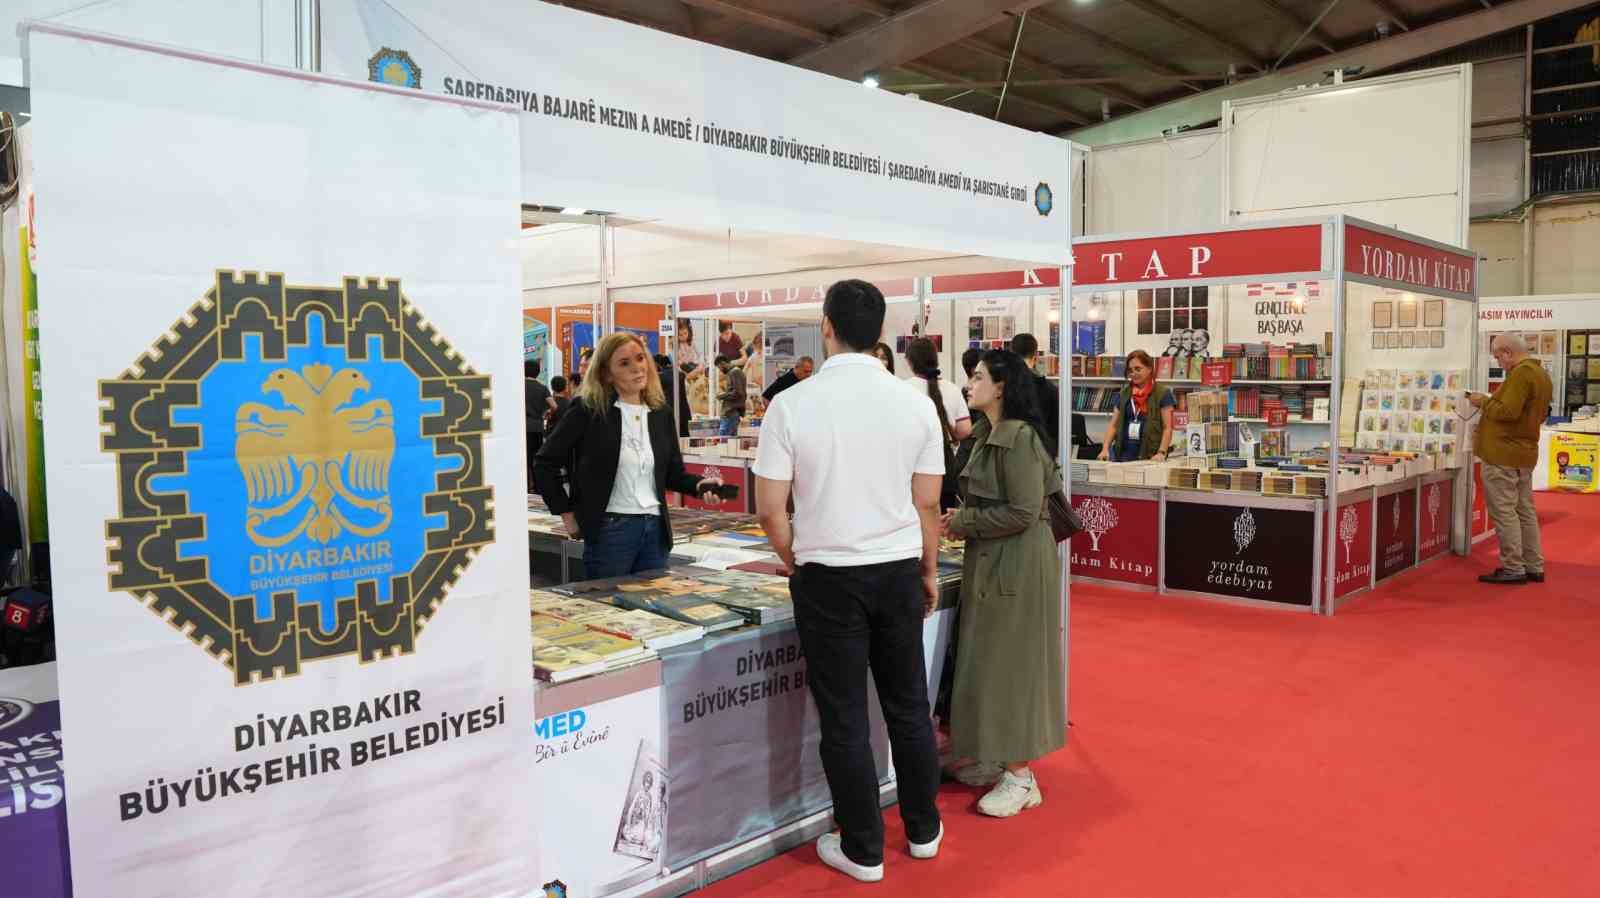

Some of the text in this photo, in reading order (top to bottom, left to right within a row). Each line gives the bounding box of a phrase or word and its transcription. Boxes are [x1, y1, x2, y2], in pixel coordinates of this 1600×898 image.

[543, 94, 596, 123] BAJARÊ
[599, 105, 638, 131] MEZIN
[641, 114, 650, 133] A
[653, 117, 693, 141] AMEDÊ
[703, 121, 769, 154] DİYARBAKIR
[770, 135, 830, 166] BÜYÜKŞEHİR
[832, 151, 881, 175] BELEDİYESİ
[962, 175, 972, 193] YA
[1361, 244, 1472, 293] YORDAM KİTAP
[1257, 318, 1304, 337] BAŞ BAŞA
[249, 540, 393, 576] DİYARBAKIR
[1109, 556, 1154, 577] Kitap
[1211, 559, 1270, 577] yordam
[11, 610, 22, 623] 8
[683, 672, 790, 724] BÜYÜKŞEHİR
[234, 688, 422, 753] DİYARBAKIR
[119, 696, 506, 822] BÜYÜKŞEHİR BELEDİYESİ
